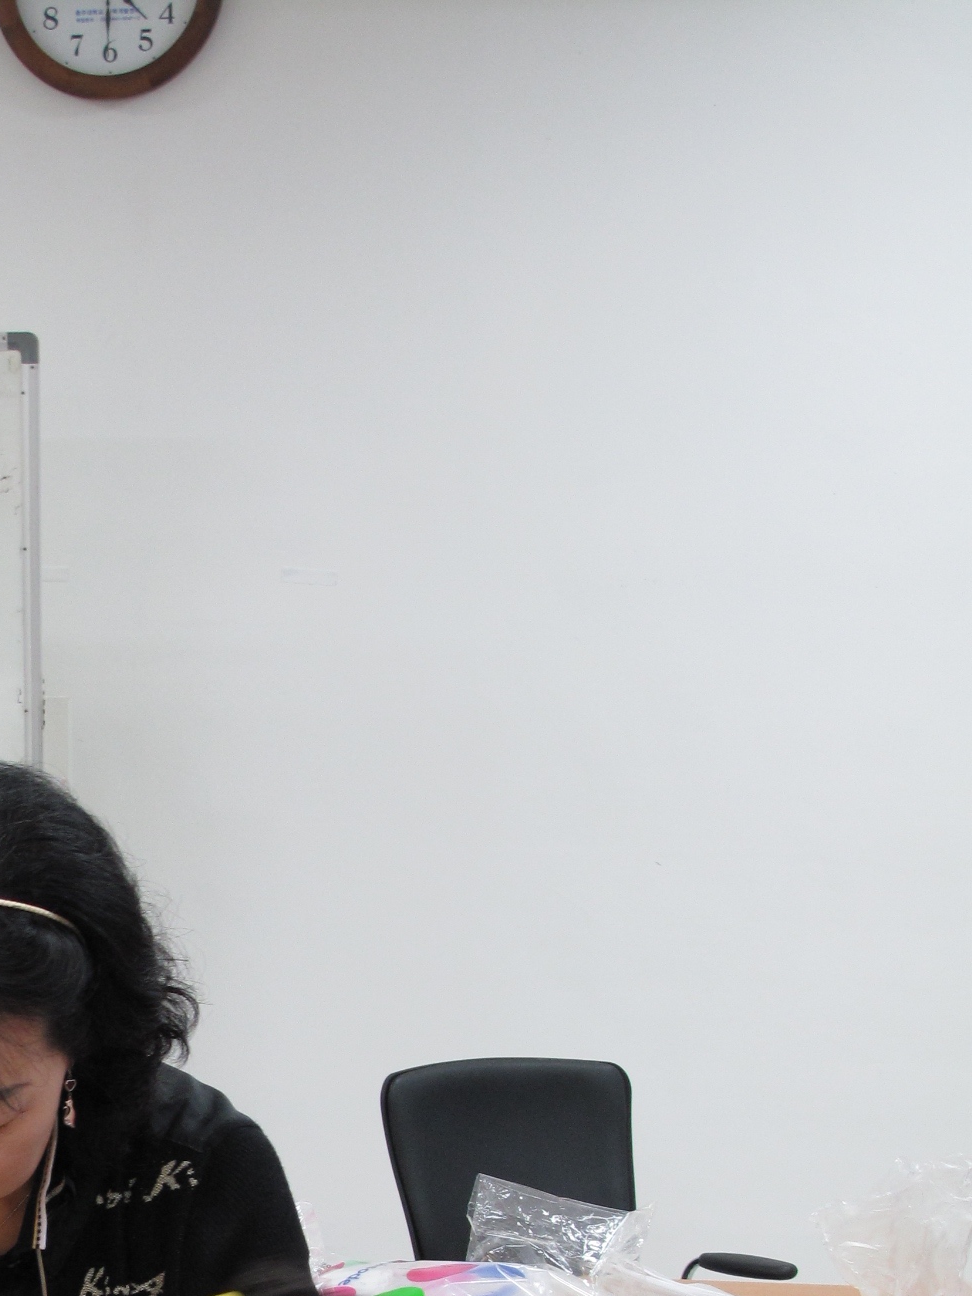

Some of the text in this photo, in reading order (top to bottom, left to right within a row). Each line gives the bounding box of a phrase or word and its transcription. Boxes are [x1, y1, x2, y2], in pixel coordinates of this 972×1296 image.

[43, 6, 58, 30] 8
[159, 2, 175, 24] 4
[70, 34, 83, 56] 7
[102, 39, 118, 62] 6
[138, 28, 153, 51] 5
